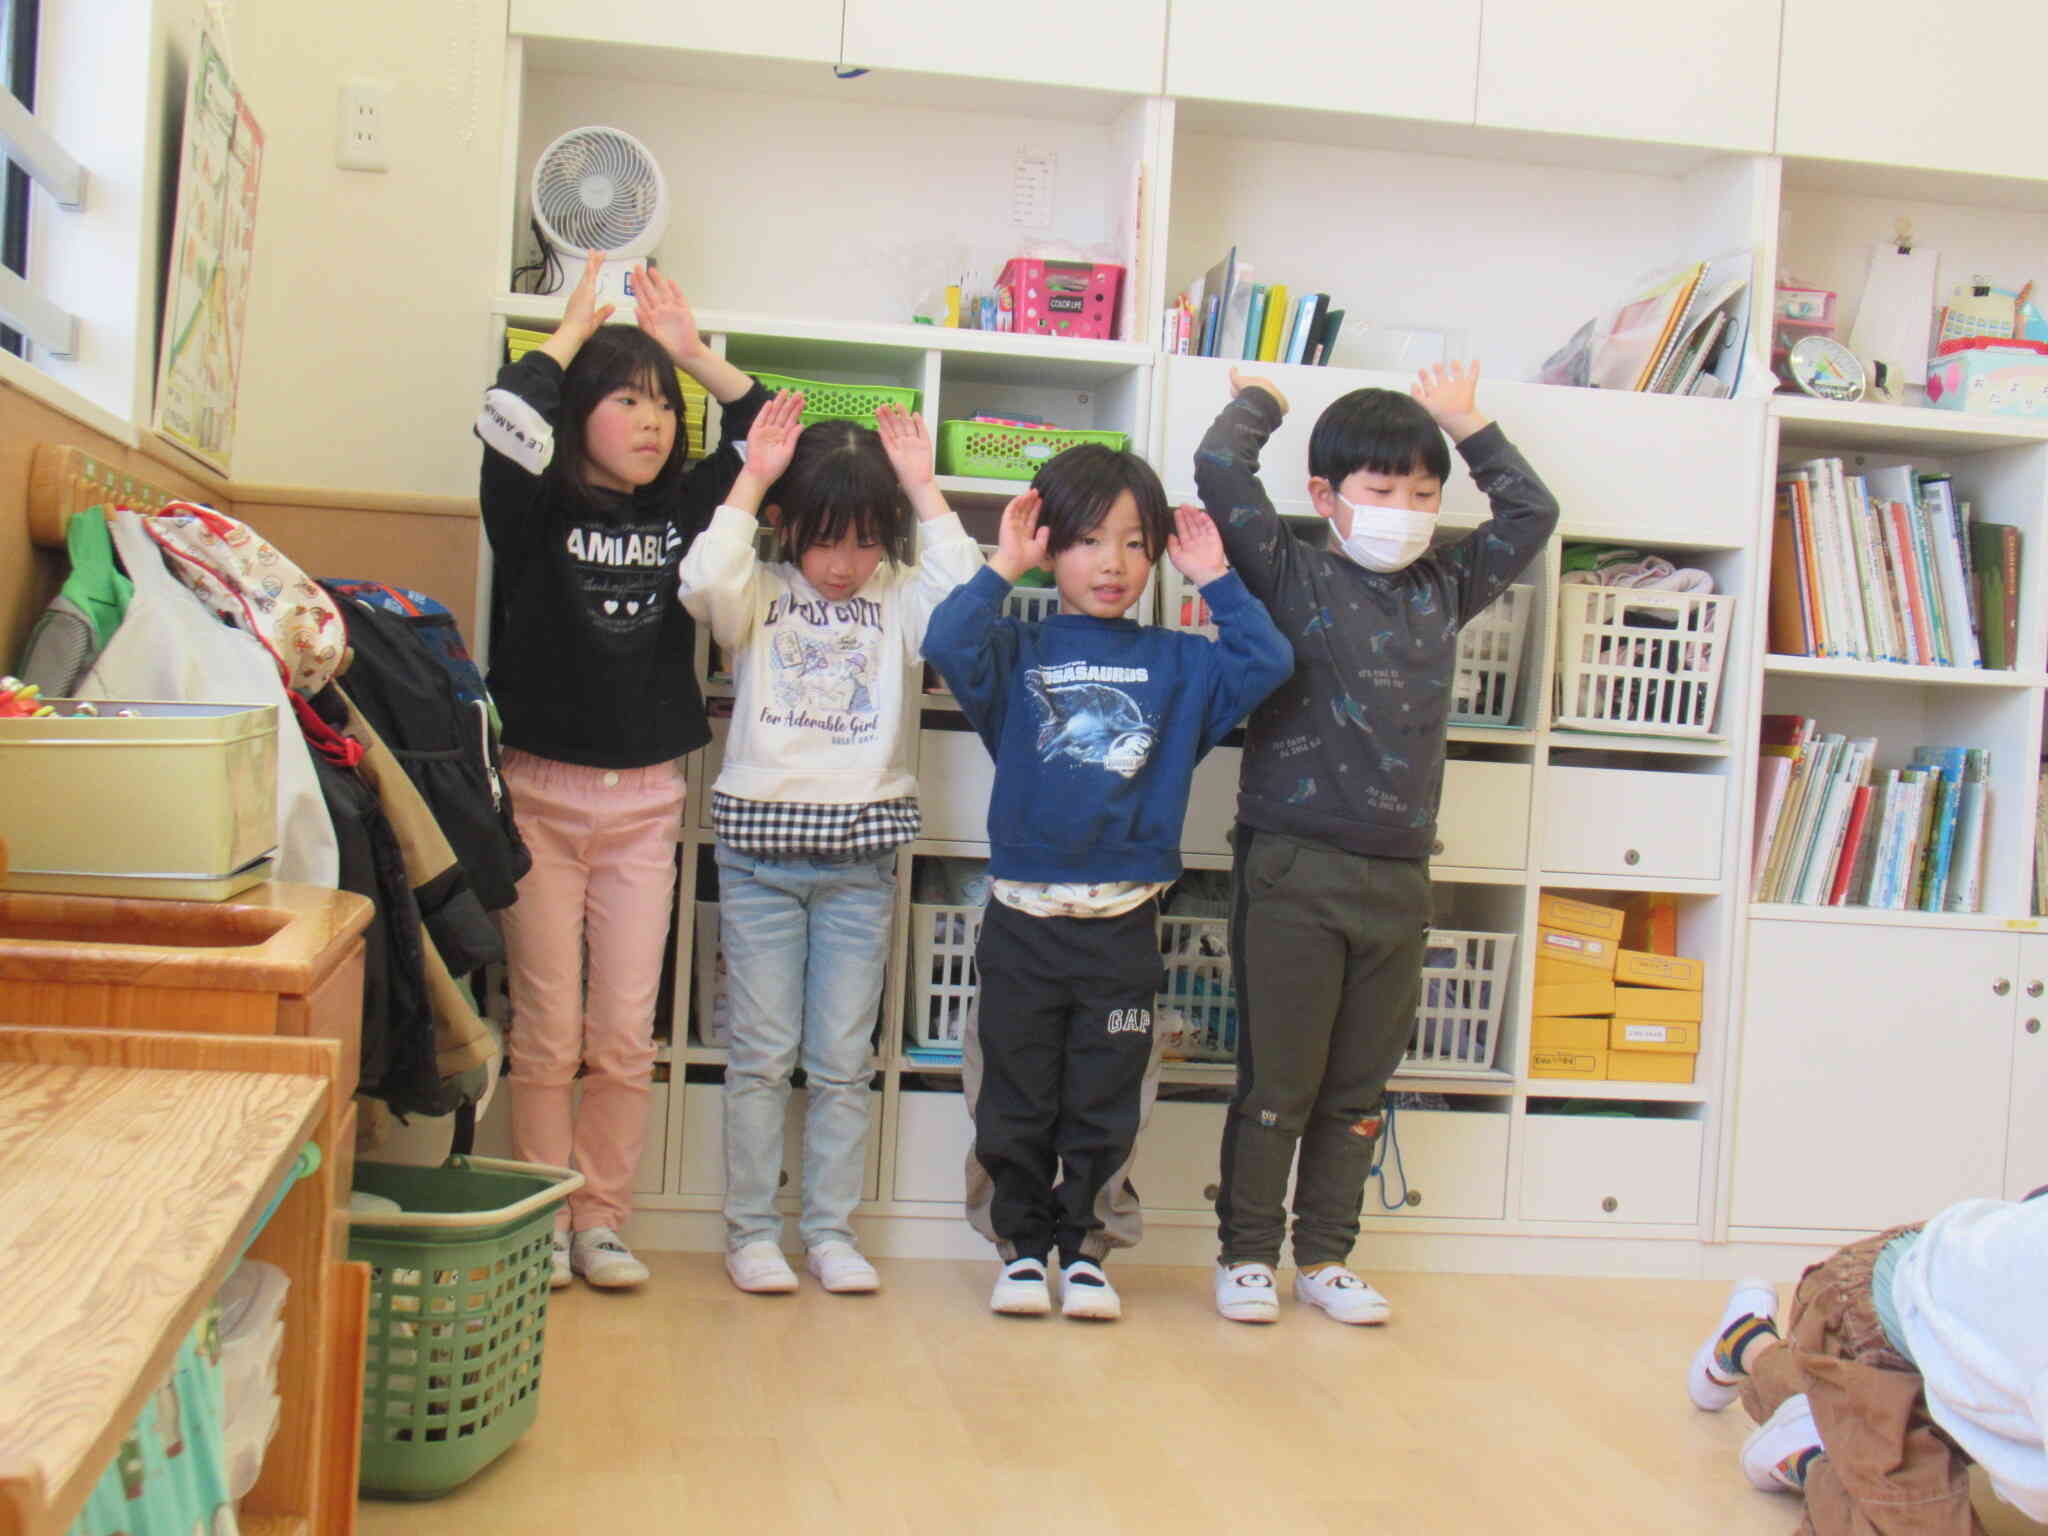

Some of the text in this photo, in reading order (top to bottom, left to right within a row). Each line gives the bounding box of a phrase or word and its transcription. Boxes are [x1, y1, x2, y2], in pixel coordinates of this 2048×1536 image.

[566, 521, 682, 567] AMIABLE
[759, 706, 879, 736] For Adorable Girl
[1108, 1008, 1151, 1034] GAP
